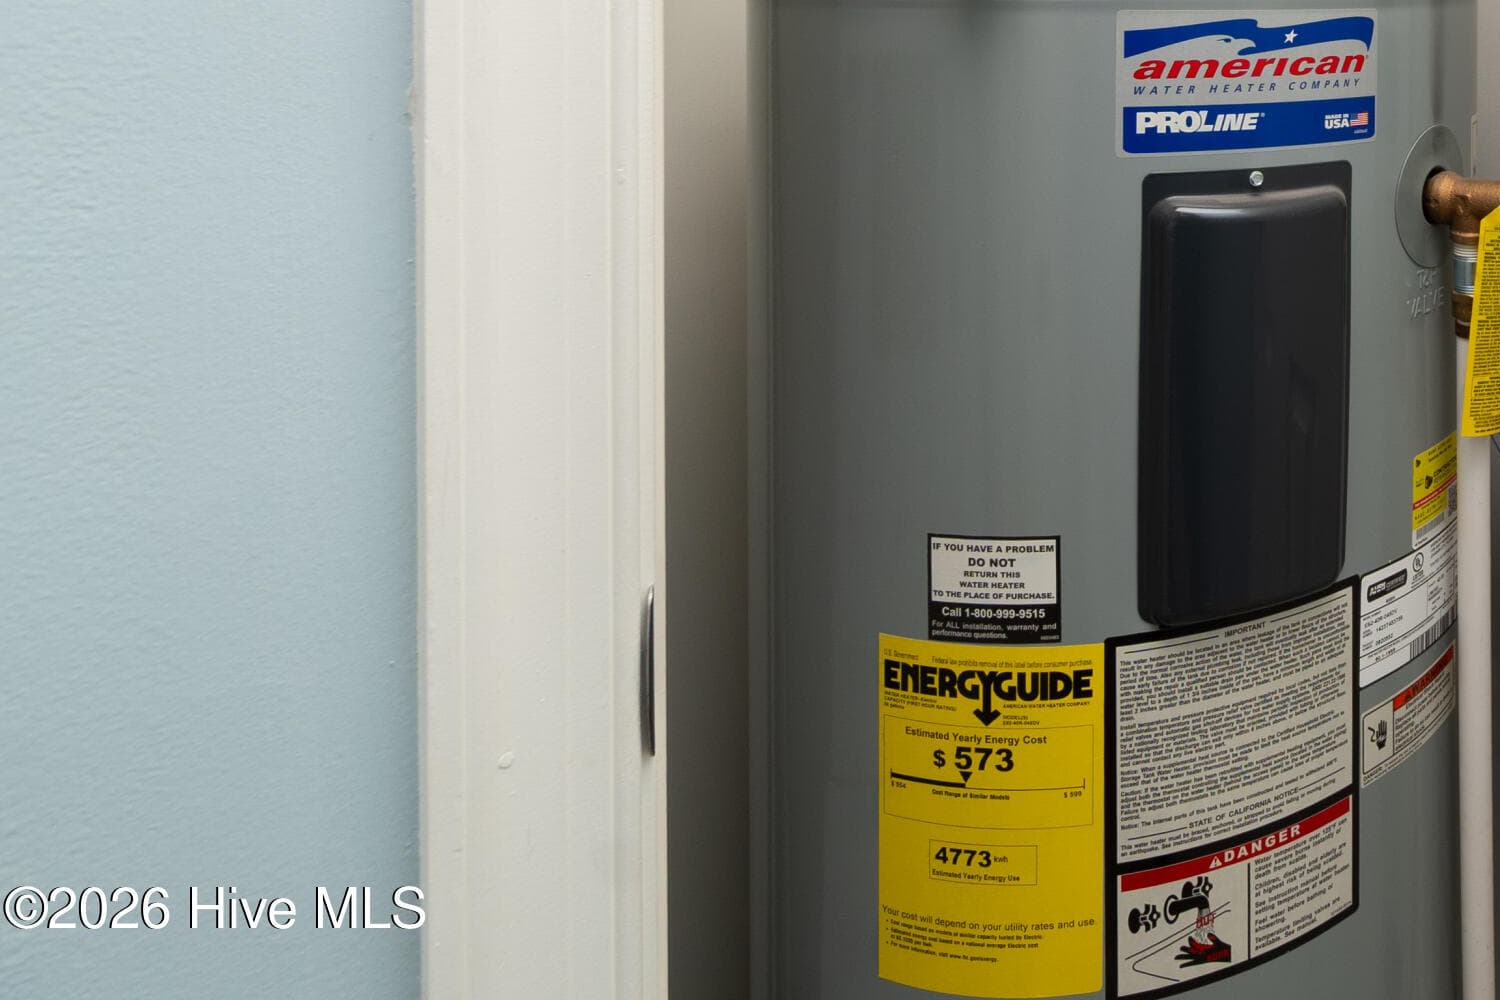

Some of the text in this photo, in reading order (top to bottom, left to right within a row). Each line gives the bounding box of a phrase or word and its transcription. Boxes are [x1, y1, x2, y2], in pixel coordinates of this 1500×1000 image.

[1133, 55, 1365, 80] american
[1133, 78, 1360, 95] WATER HEATER COMPANY
[1325, 118, 1349, 129] USA
[932, 542, 941, 550] IF
[944, 543, 963, 551] YOU
[967, 545, 993, 553] HAVE
[1005, 545, 1054, 553] PROBLEM
[963, 570, 998, 578] RETURN
[968, 557, 1016, 568] DO NOT
[959, 581, 988, 589] WATER
[1005, 592, 1055, 600] PURCHASE.
[942, 606, 1046, 619] Call 1-800-999-9515
[932, 620, 943, 628] For
[945, 621, 960, 630] ALL
[1006, 624, 1039, 632] warranty
[1042, 622, 1057, 630] and
[1224, 620, 1265, 638] IMPORTANT
[884, 658, 1093, 702] ENERGYGUIDE
[905, 726, 1047, 746] Estimated Yearly Energy Cost
[933, 746, 1014, 772] $ 573
[1189, 786, 1299, 828] STATE OF CALIFORNIA NOTICE
[1224, 825, 1301, 863] DANGER
[1255, 855, 1271, 865] Water
[1274, 840, 1306, 858] temperature
[1309, 832, 1321, 842] over
[1338, 817, 1347, 826] can
[1255, 862, 1272, 872] cause
[1275, 853, 1293, 865] severe
[1295, 844, 1311, 855] burns
[1313, 833, 1334, 847] instantly
[935, 846, 992, 868] 4773
[1255, 853, 1307, 879] death from scalds.
[1255, 876, 1281, 890] Children,
[1283, 863, 1306, 879] disabled
[1309, 857, 1318, 866] and
[1320, 847, 1337, 861] elderly
[932, 869, 961, 878] Estimated
[963, 872, 982, 881] Yearly
[984, 874, 1006, 882] Energy
[1255, 864, 1337, 908] See instruction manual before
[1263, 880, 1284, 894] highest
[1286, 874, 1297, 884] risk
[1307, 863, 1321, 874] being
[1255, 903, 1275, 915] setting
[1277, 887, 1310, 906] temperature
[1319, 873, 1332, 885] water
[1334, 863, 1350, 875] heater
[882, 904, 1095, 932] Your cost will depend on your utility rates and use
[1255, 915, 1267, 925] Feel
[1270, 908, 1285, 919] water
[1288, 900, 1305, 912] before
[1307, 888, 1326, 902] bathing
[1255, 925, 1290, 943] Temperature
[1293, 912, 1313, 927] limiting
[1314, 902, 1330, 915] valves
[1255, 915, 1286, 932] showering.
[1255, 917, 1317, 950] available. See manual.
